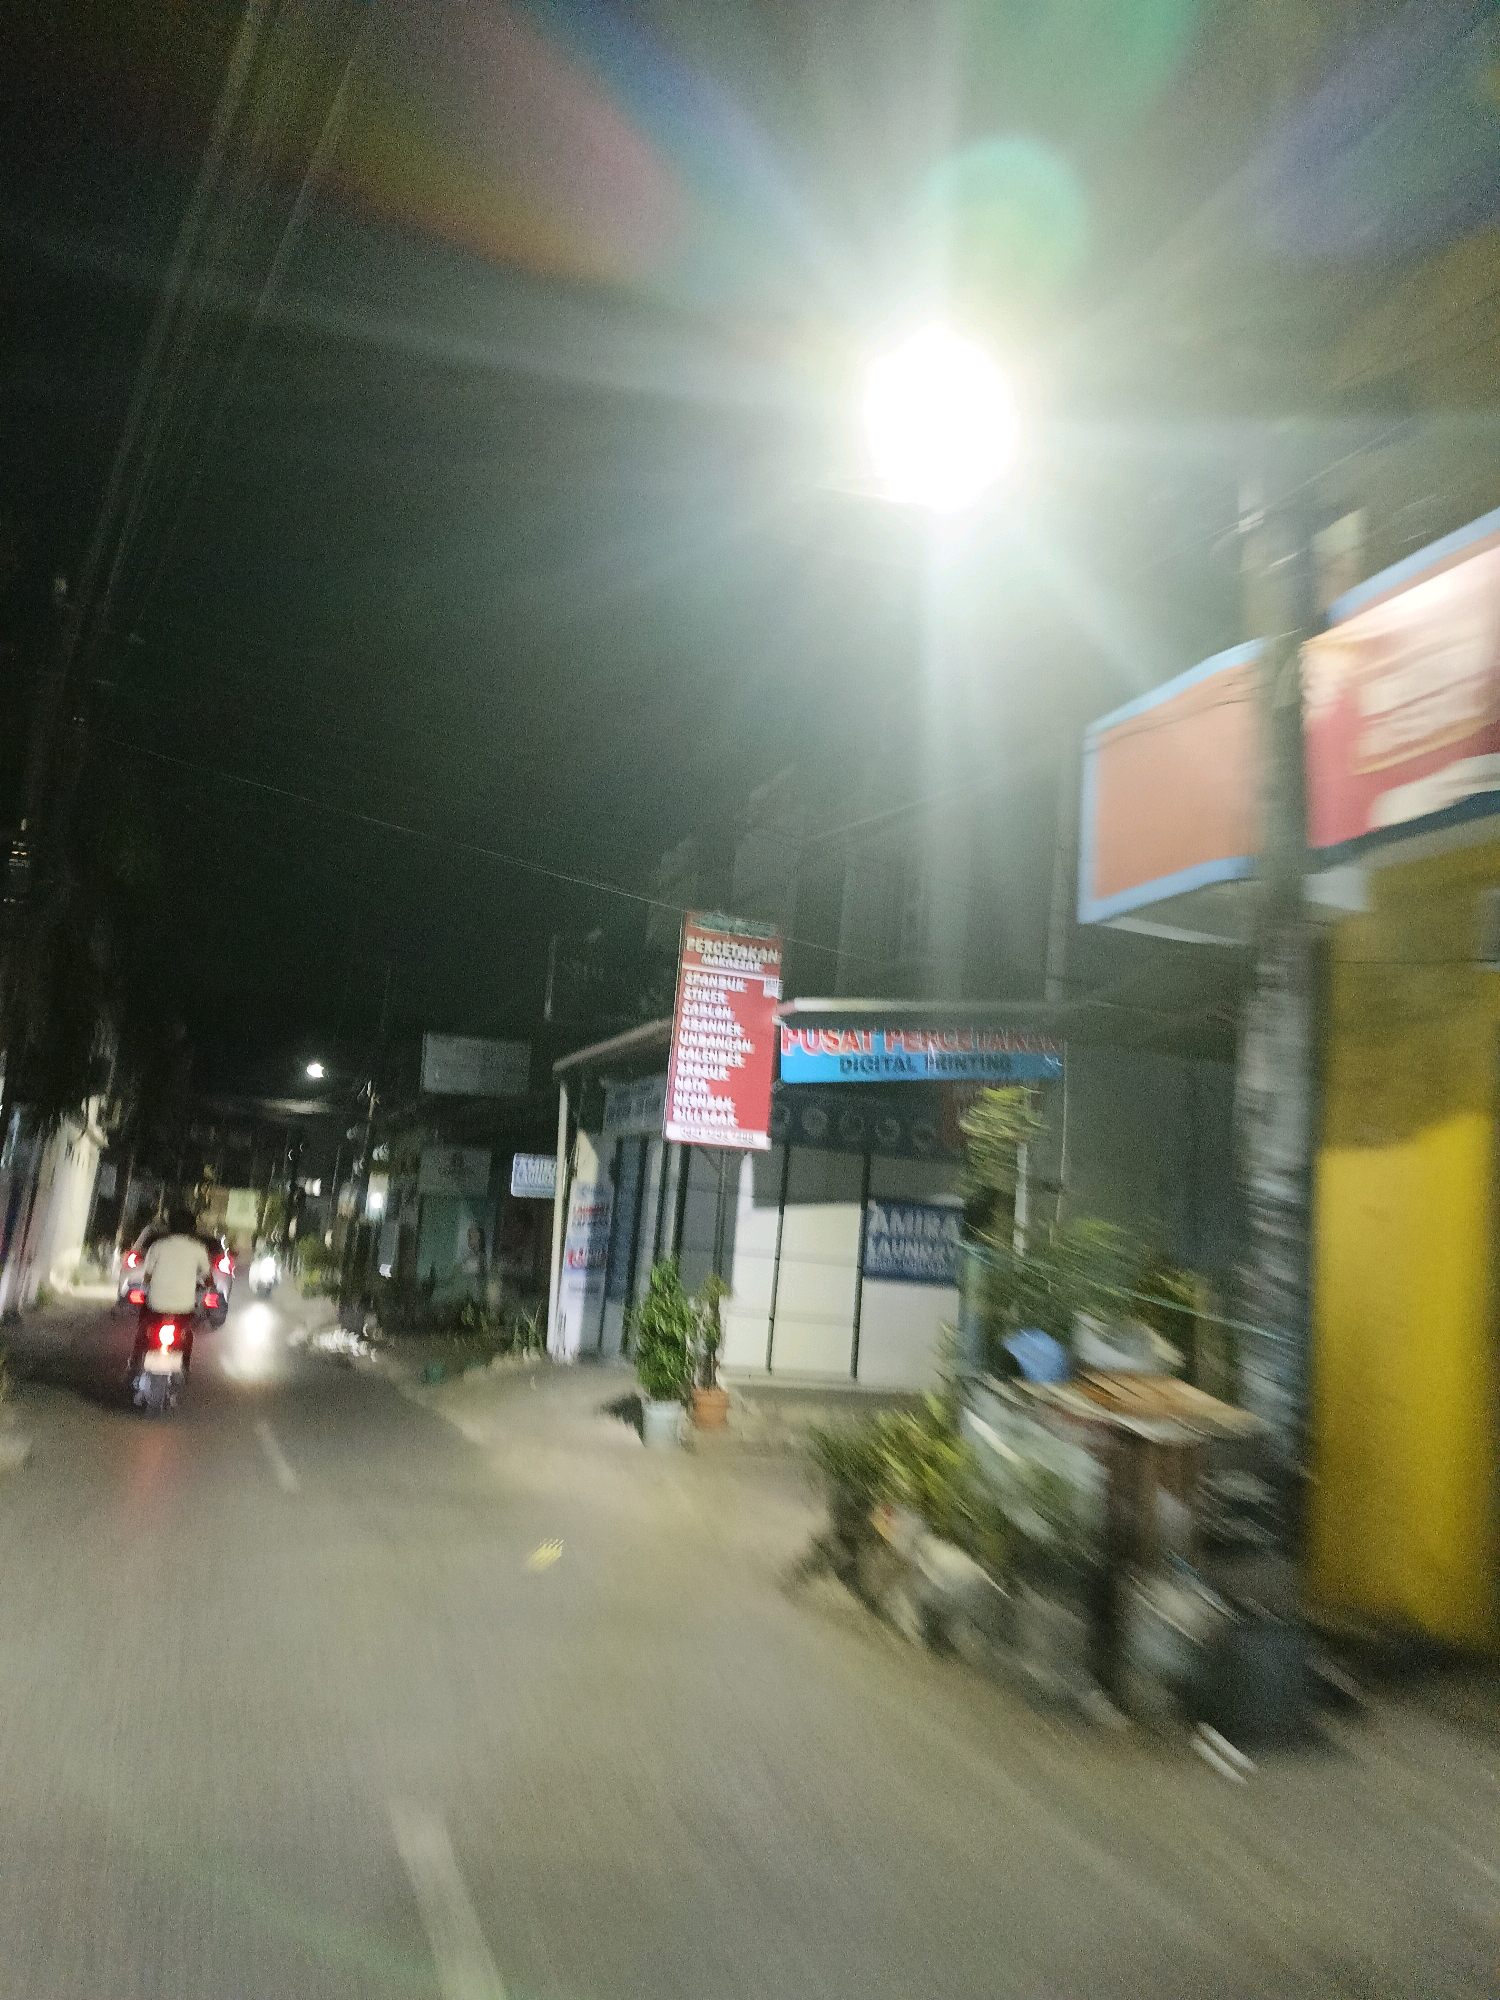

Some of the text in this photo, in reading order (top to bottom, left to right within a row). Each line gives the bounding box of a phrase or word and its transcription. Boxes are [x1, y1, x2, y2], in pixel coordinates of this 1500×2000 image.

[686, 936, 782, 964] PERCETAKAN
[684, 971, 748, 993] SPANDUK
[683, 986, 729, 1006] STIKER
[682, 1001, 734, 1021] SABLON
[679, 1030, 755, 1054] UNDANGAN
[781, 1025, 875, 1056] PUSAT
[677, 1045, 746, 1068] KALENDER
[839, 1053, 1012, 1075] DIGITAL PRINTING
[676, 1060, 730, 1082] BROSUR
[674, 1075, 710, 1095] NOTA
[867, 1204, 960, 1241] AMIRA
